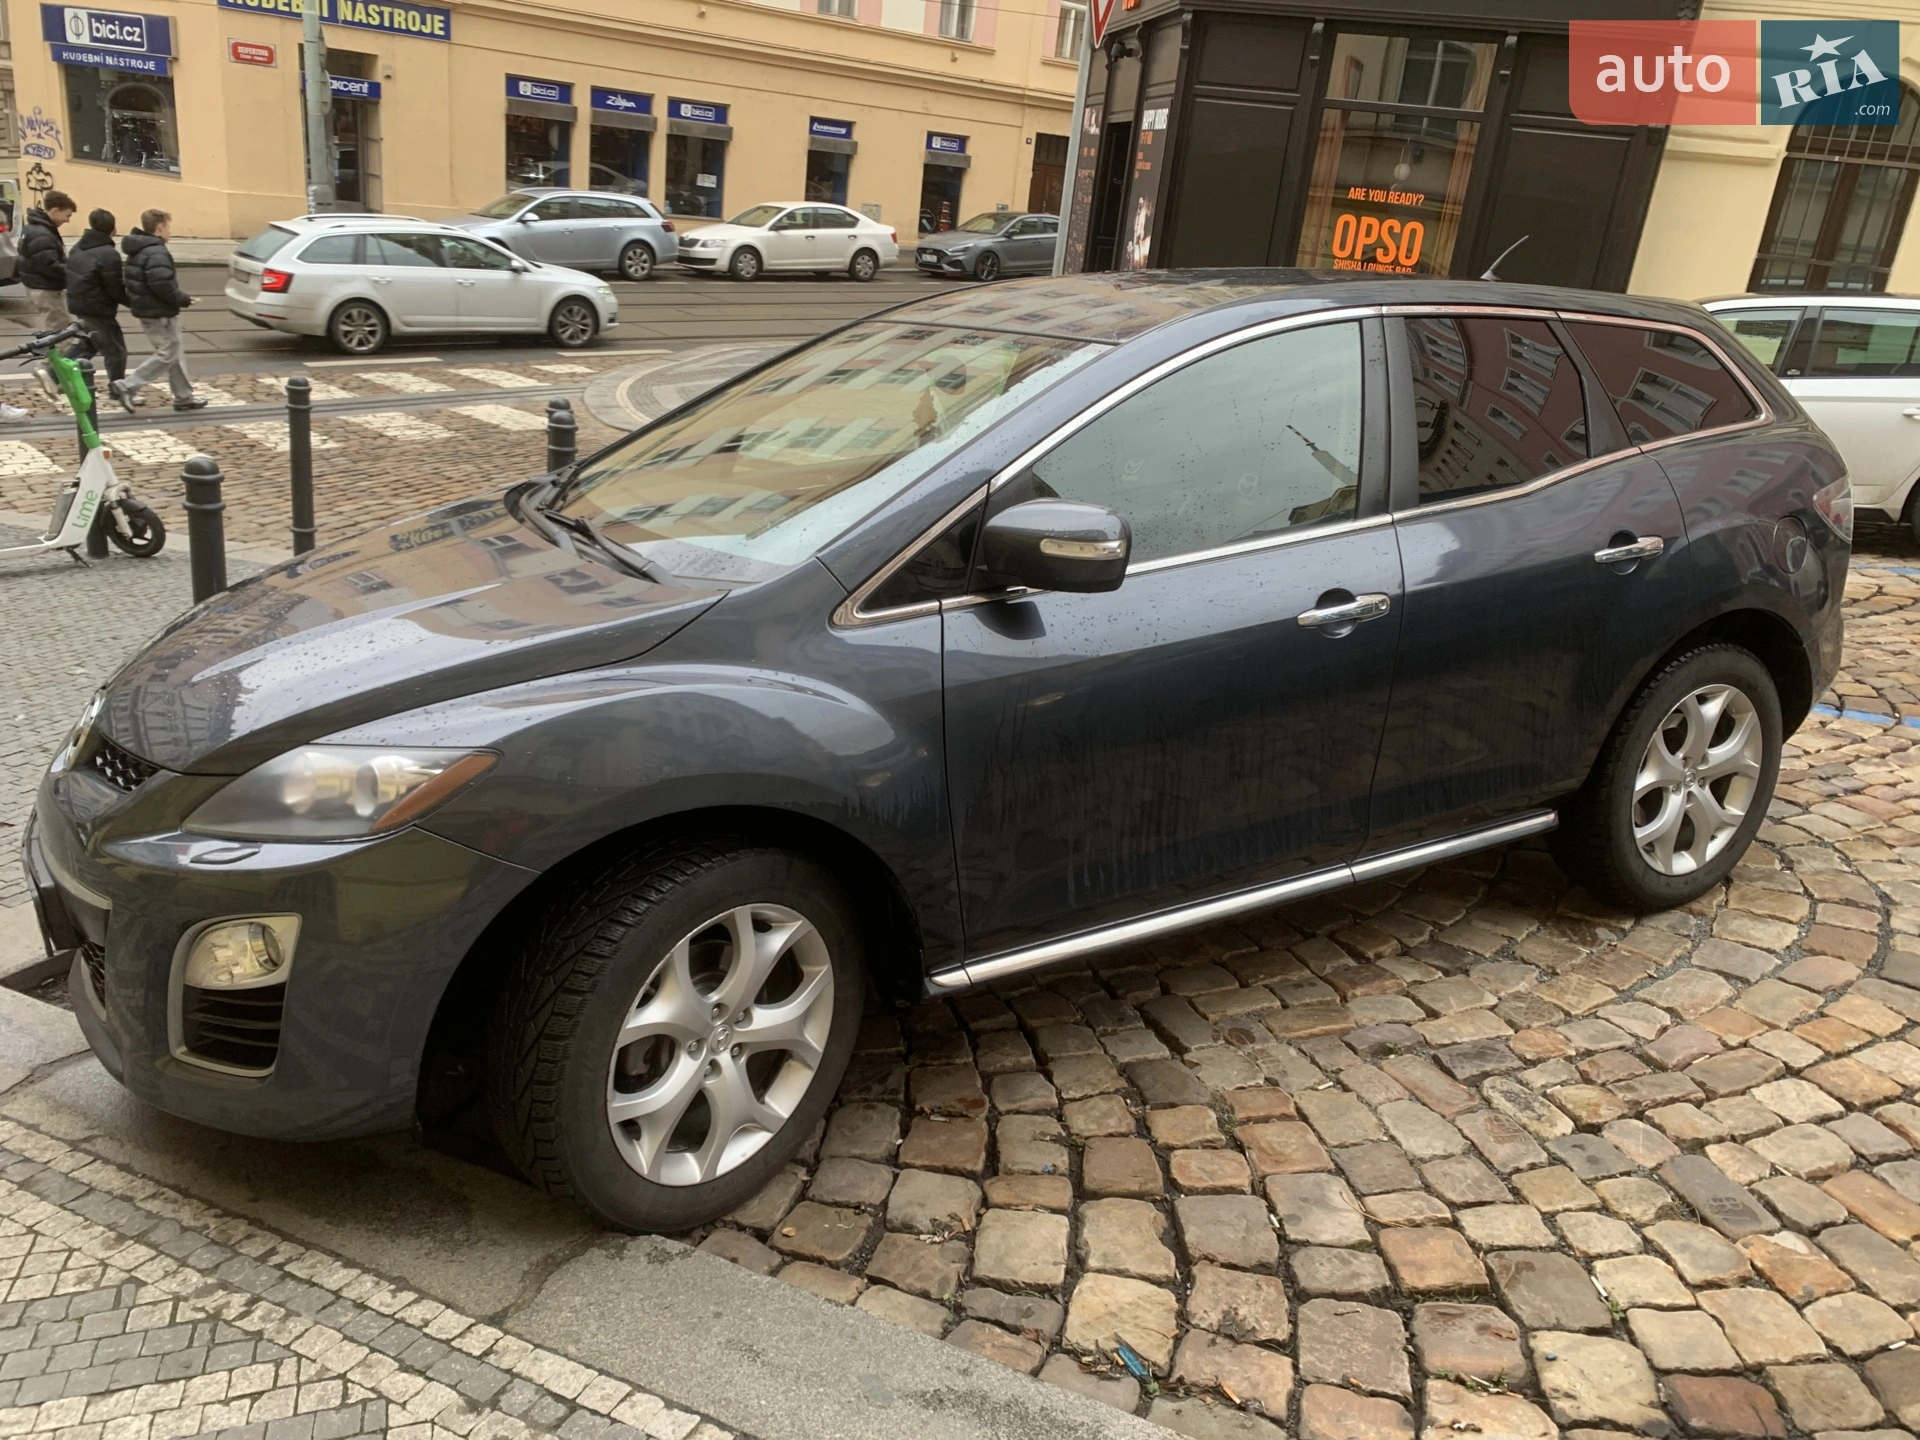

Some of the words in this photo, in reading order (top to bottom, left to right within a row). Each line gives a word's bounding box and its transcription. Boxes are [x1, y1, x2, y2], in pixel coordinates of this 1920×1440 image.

[340, 0, 445, 36] NÁSTROJE
[91, 18, 142, 42] bici.cz
[62, 51, 104, 64] HUDEBNÍ
[105, 54, 156, 70] NÁSTROJE
[532, 85, 557, 97] bici.cz
[692, 107, 714, 118] bici.cz
[1348, 187, 1367, 200] ARE
[1369, 188, 1387, 203] YOU
[1387, 191, 1425, 206] READY?
[1332, 214, 1425, 267] OPSO
[1333, 258, 1362, 271] SHISHA
[71, 489, 98, 529] Lime
